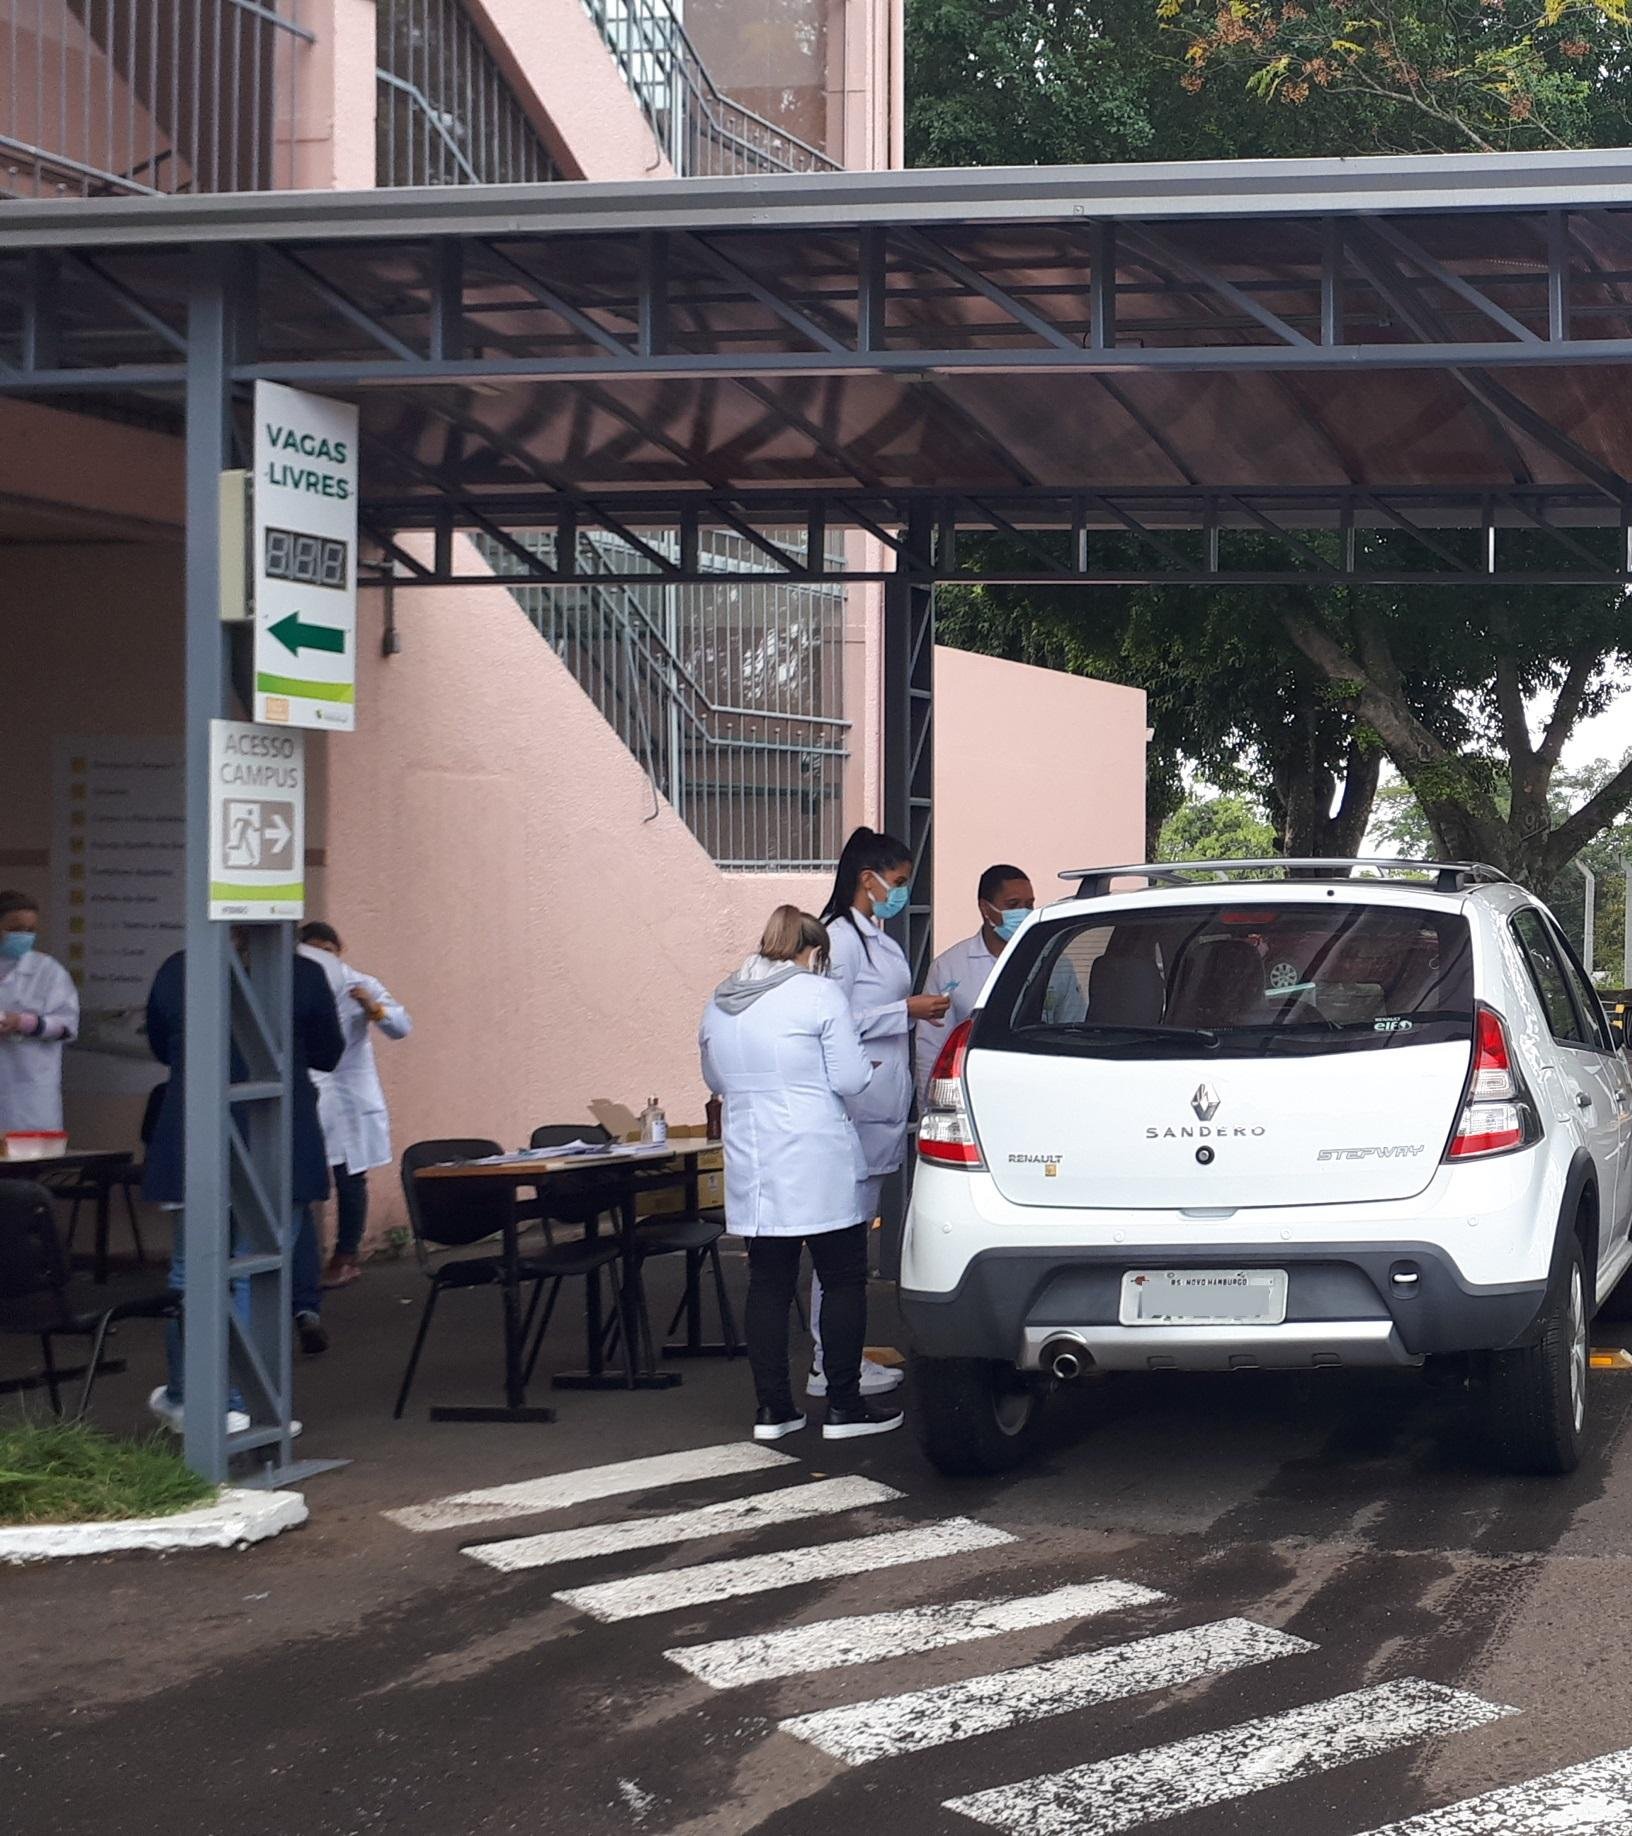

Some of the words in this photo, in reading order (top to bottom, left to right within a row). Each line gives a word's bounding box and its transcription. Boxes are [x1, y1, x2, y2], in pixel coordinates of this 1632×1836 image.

[266, 422, 347, 464] VAGAS
[268, 461, 349, 500] LIVRES
[224, 734, 294, 758] ACESSO
[220, 763, 298, 788] CAMPUS
[1146, 1126, 1266, 1139] SANDERO
[1008, 1154, 1063, 1163] RENAULT
[1317, 1145, 1425, 1161] STEPWAY
[1207, 1278, 1248, 1286] HAMBURGO
